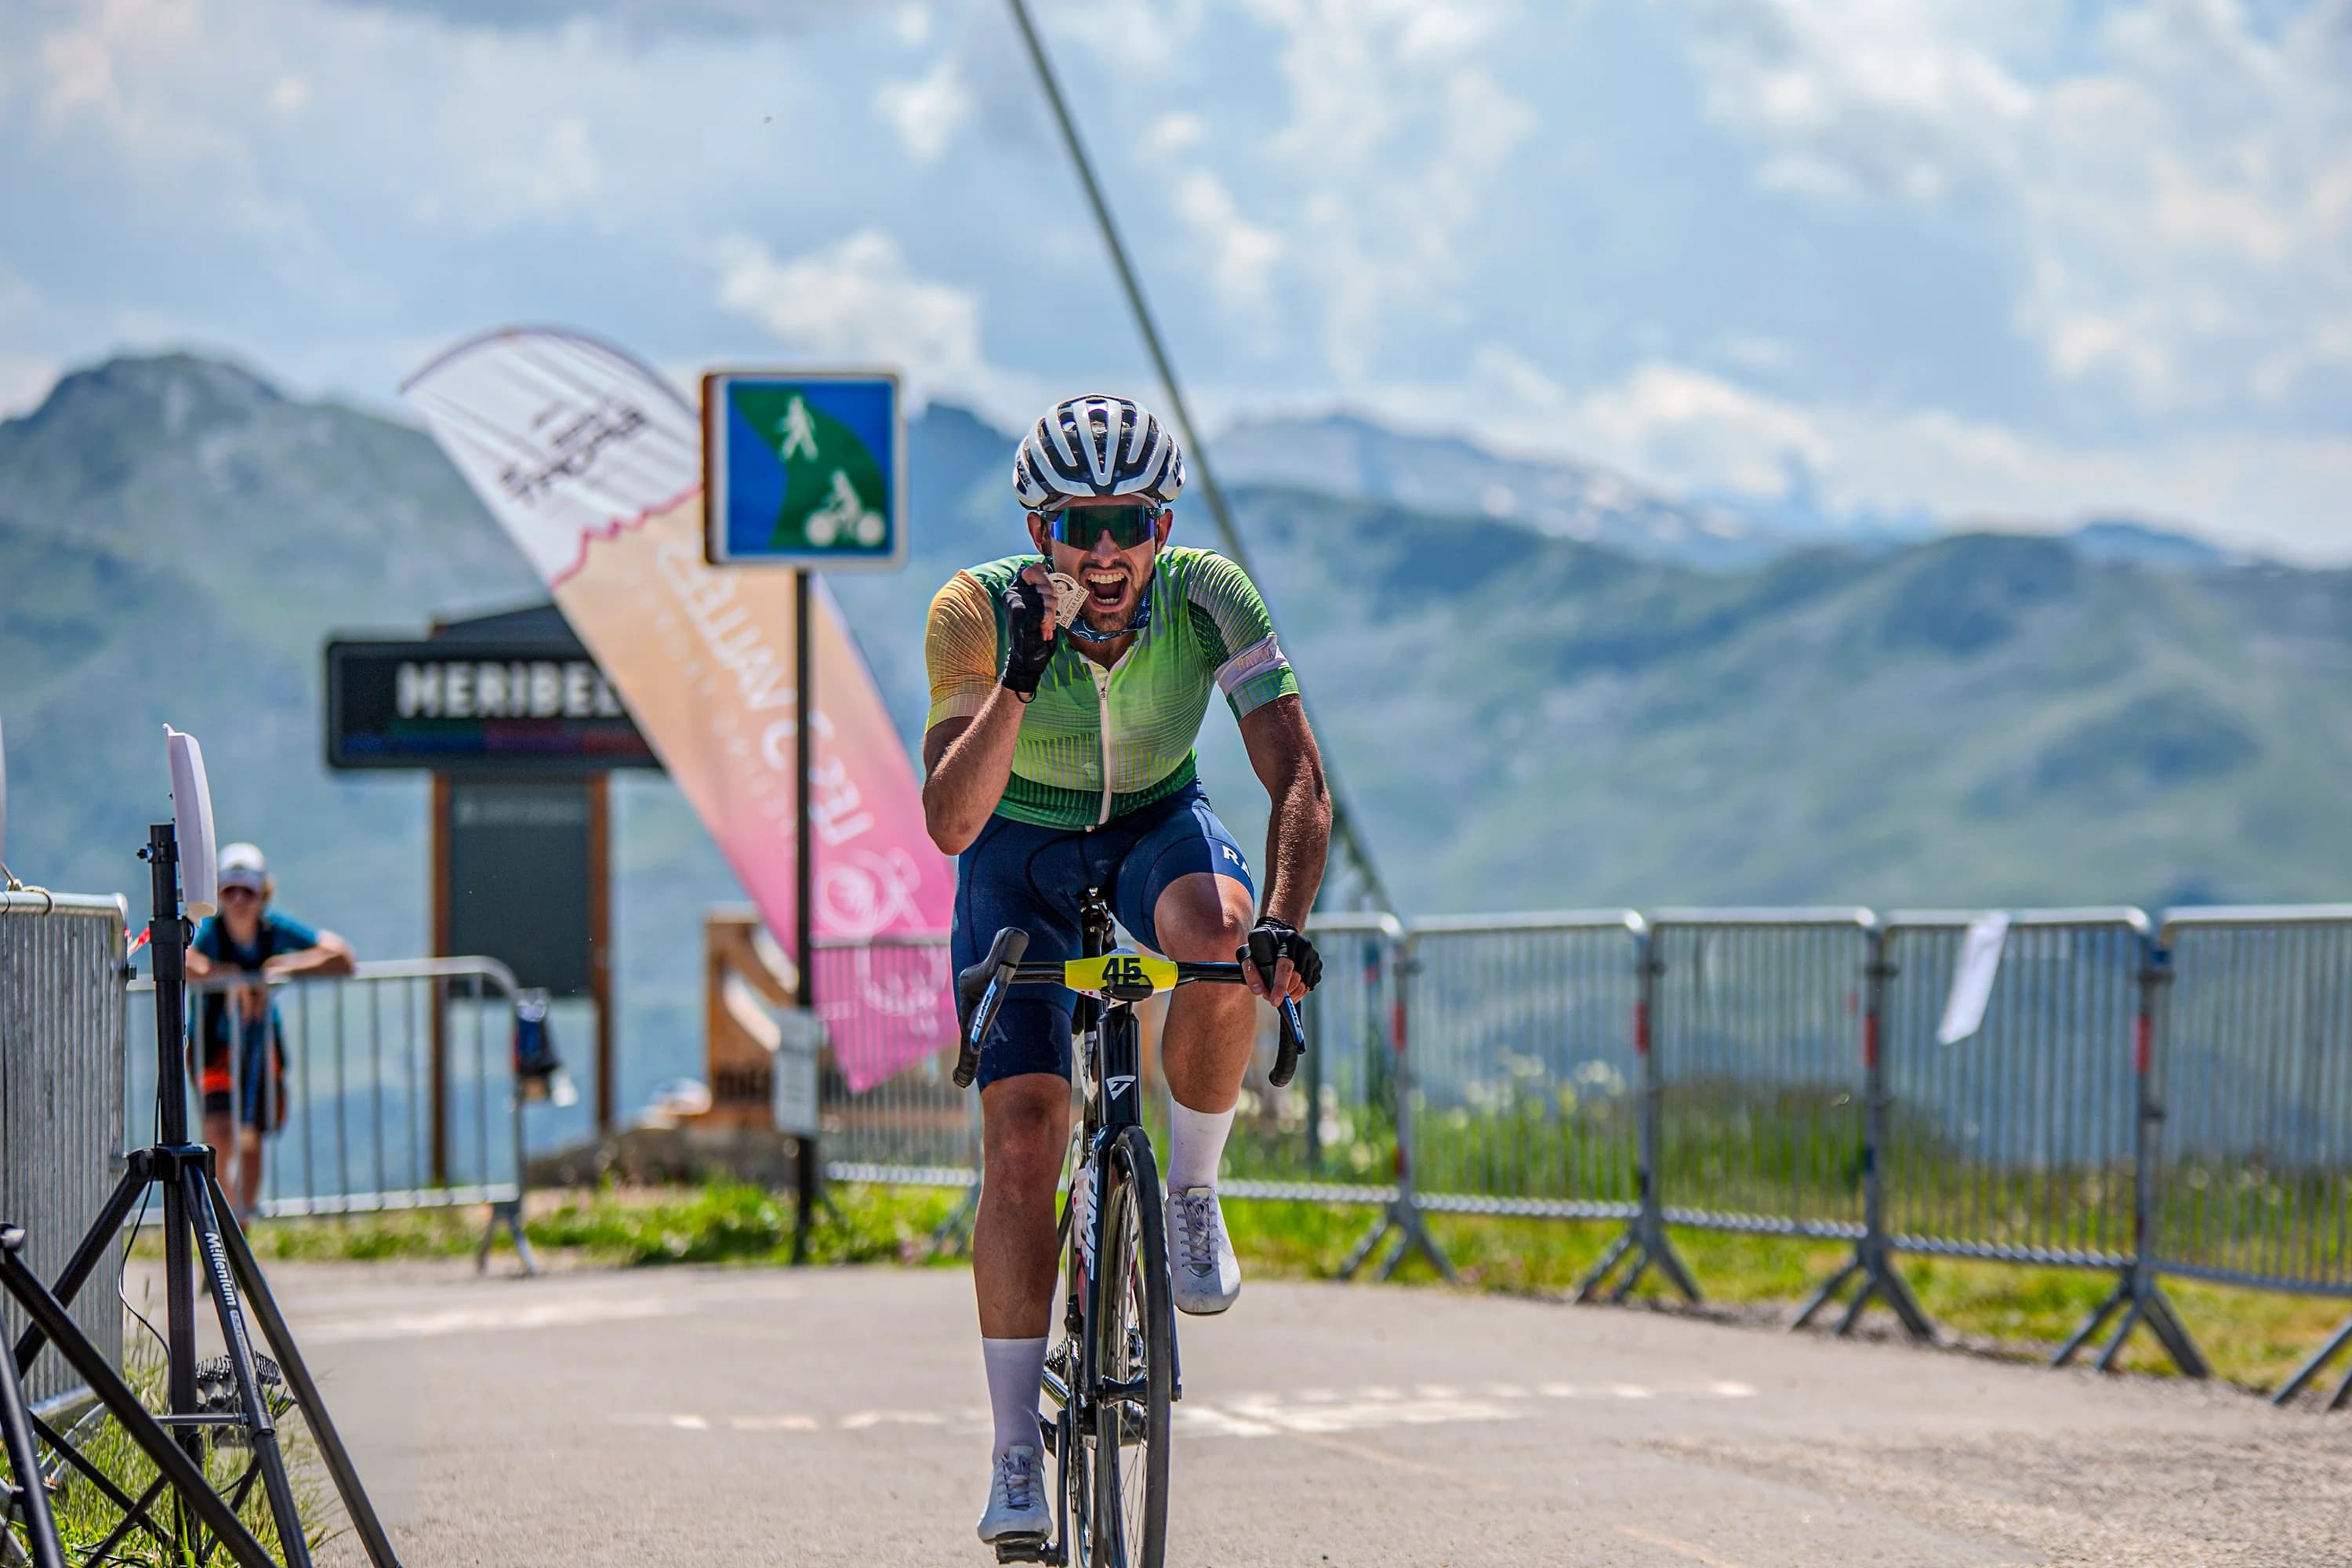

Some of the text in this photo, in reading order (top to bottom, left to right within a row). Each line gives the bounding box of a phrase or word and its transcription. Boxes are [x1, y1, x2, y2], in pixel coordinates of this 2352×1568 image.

[1060, 615, 1069, 626] COL
[1075, 586, 1086, 602] LOZE
[1102, 957, 1142, 985] 45
[1085, 1160, 1098, 1281] TIME
[205, 1232, 237, 1307] Millenium
